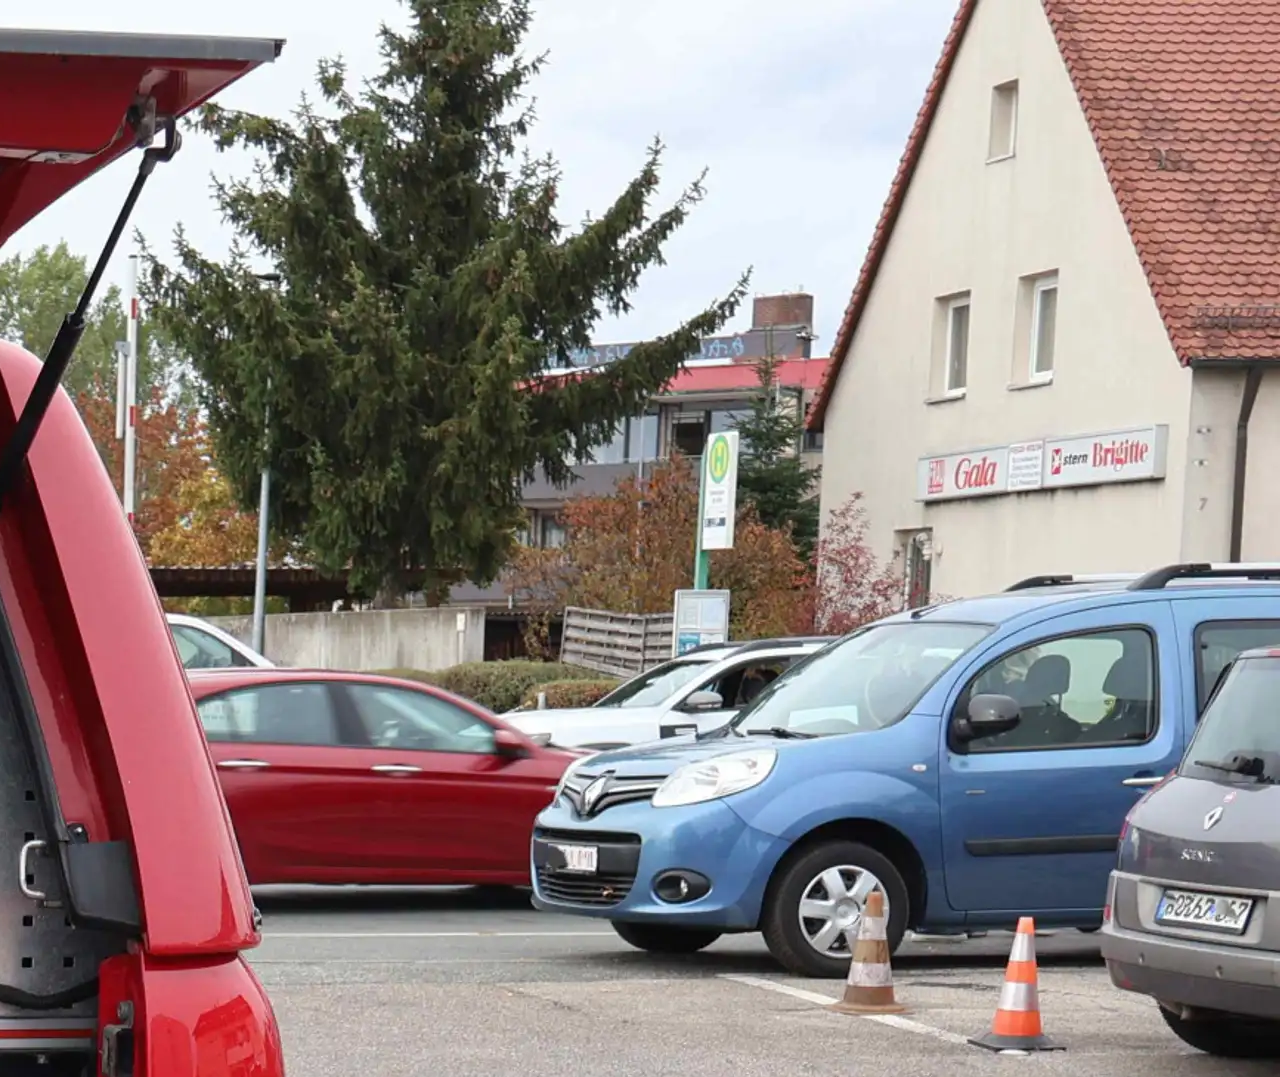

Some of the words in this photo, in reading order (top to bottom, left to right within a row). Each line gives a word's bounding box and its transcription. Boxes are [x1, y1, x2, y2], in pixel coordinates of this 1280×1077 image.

[1062, 453, 1088, 466] stern
[1092, 439, 1149, 472] Brigitte
[954, 456, 997, 490] Gala
